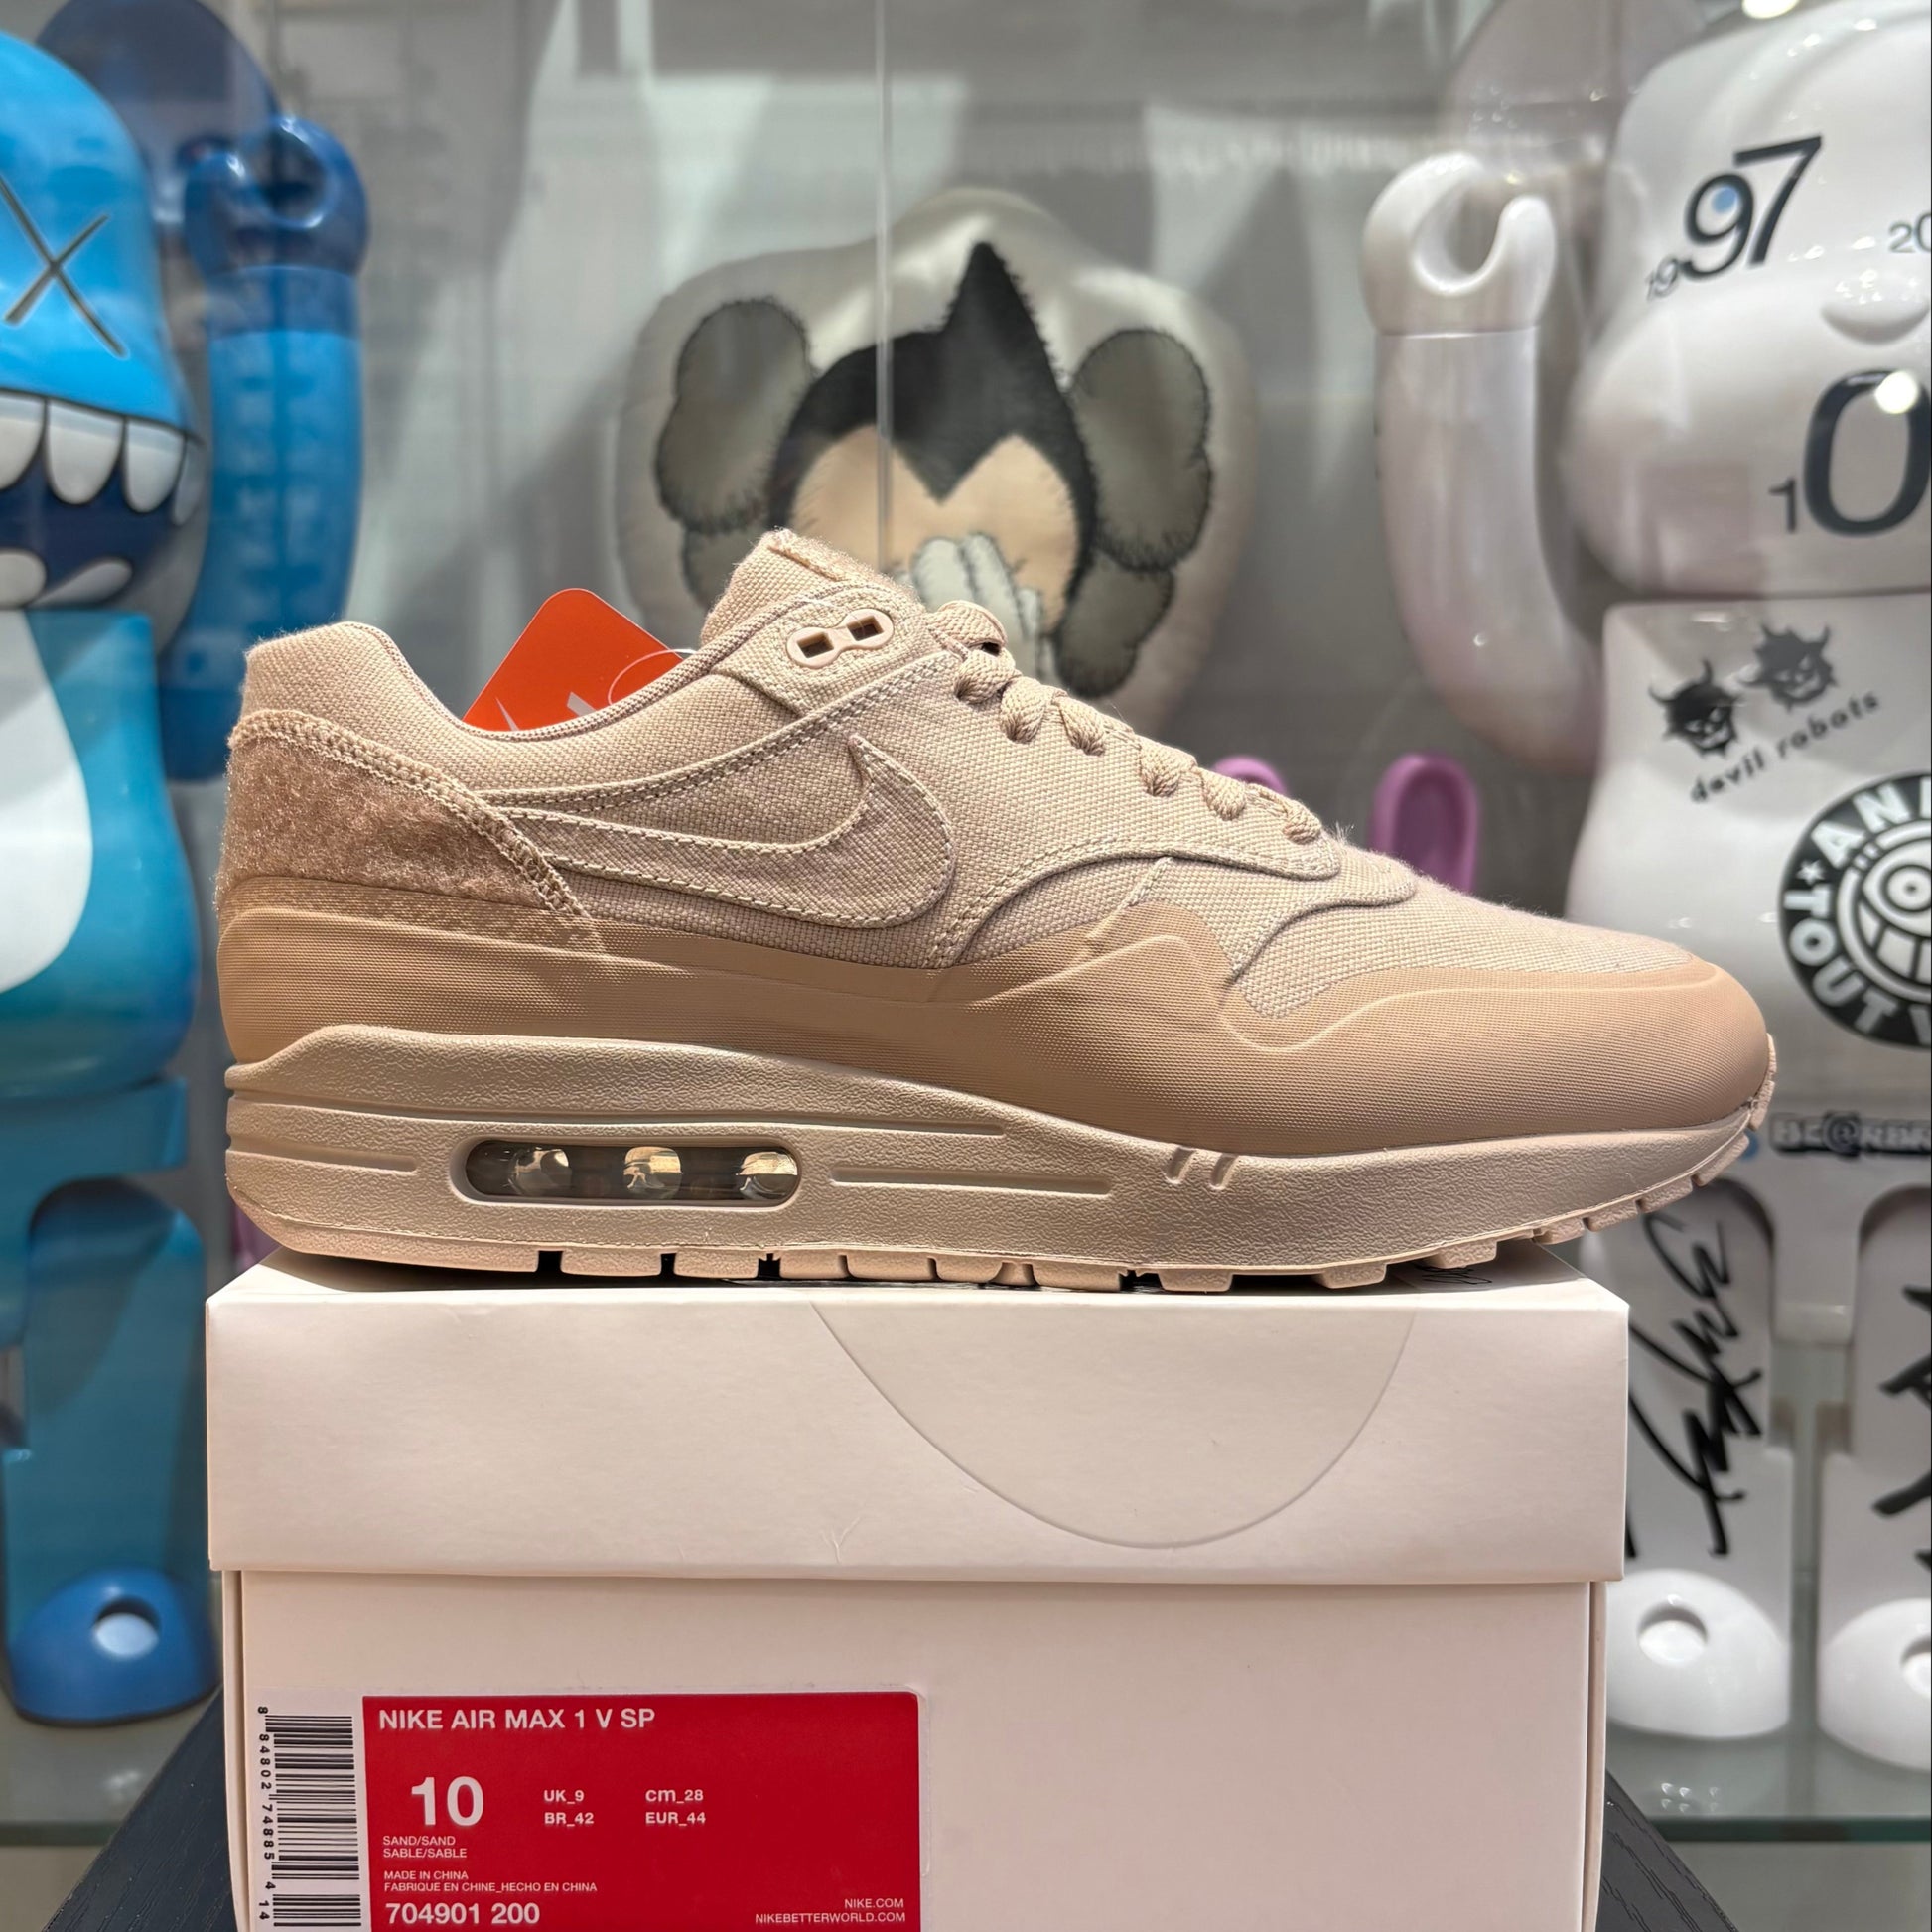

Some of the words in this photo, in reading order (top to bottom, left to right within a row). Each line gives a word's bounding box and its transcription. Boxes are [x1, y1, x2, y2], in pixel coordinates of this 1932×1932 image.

[1690, 747, 1765, 803] devil
[1775, 692, 1879, 760] robots
[379, 1709, 444, 1729] NIKE
[450, 1709, 496, 1729] AIR
[504, 1709, 565, 1729] MAX
[574, 1709, 585, 1728] 1
[596, 1708, 613, 1728] V
[621, 1708, 655, 1728] SP
[410, 1776, 484, 1827] 10
[543, 1789, 585, 1805] UK_9
[544, 1812, 595, 1827] BR_42
[645, 1812, 706, 1827] EUR_44
[382, 1836, 456, 1847] SAND/SAND
[382, 1848, 468, 1859] SABLE/SABLE
[384, 1870, 416, 1880] MADE
[419, 1870, 431, 1880] IN
[433, 1870, 469, 1880] CHINA
[384, 1882, 441, 1893] FABRIQUE
[444, 1882, 459, 1892] EN
[464, 1882, 541, 1894] CHINE_HECHO
[545, 1882, 559, 1892] EN
[562, 1882, 598, 1892] CHINA
[844, 1898, 904, 1908] NIKE.COM
[385, 1902, 480, 1925] 704901
[491, 1902, 540, 1925] 200
[755, 1912, 905, 1924] NIKEBETTERWORLD.COM
